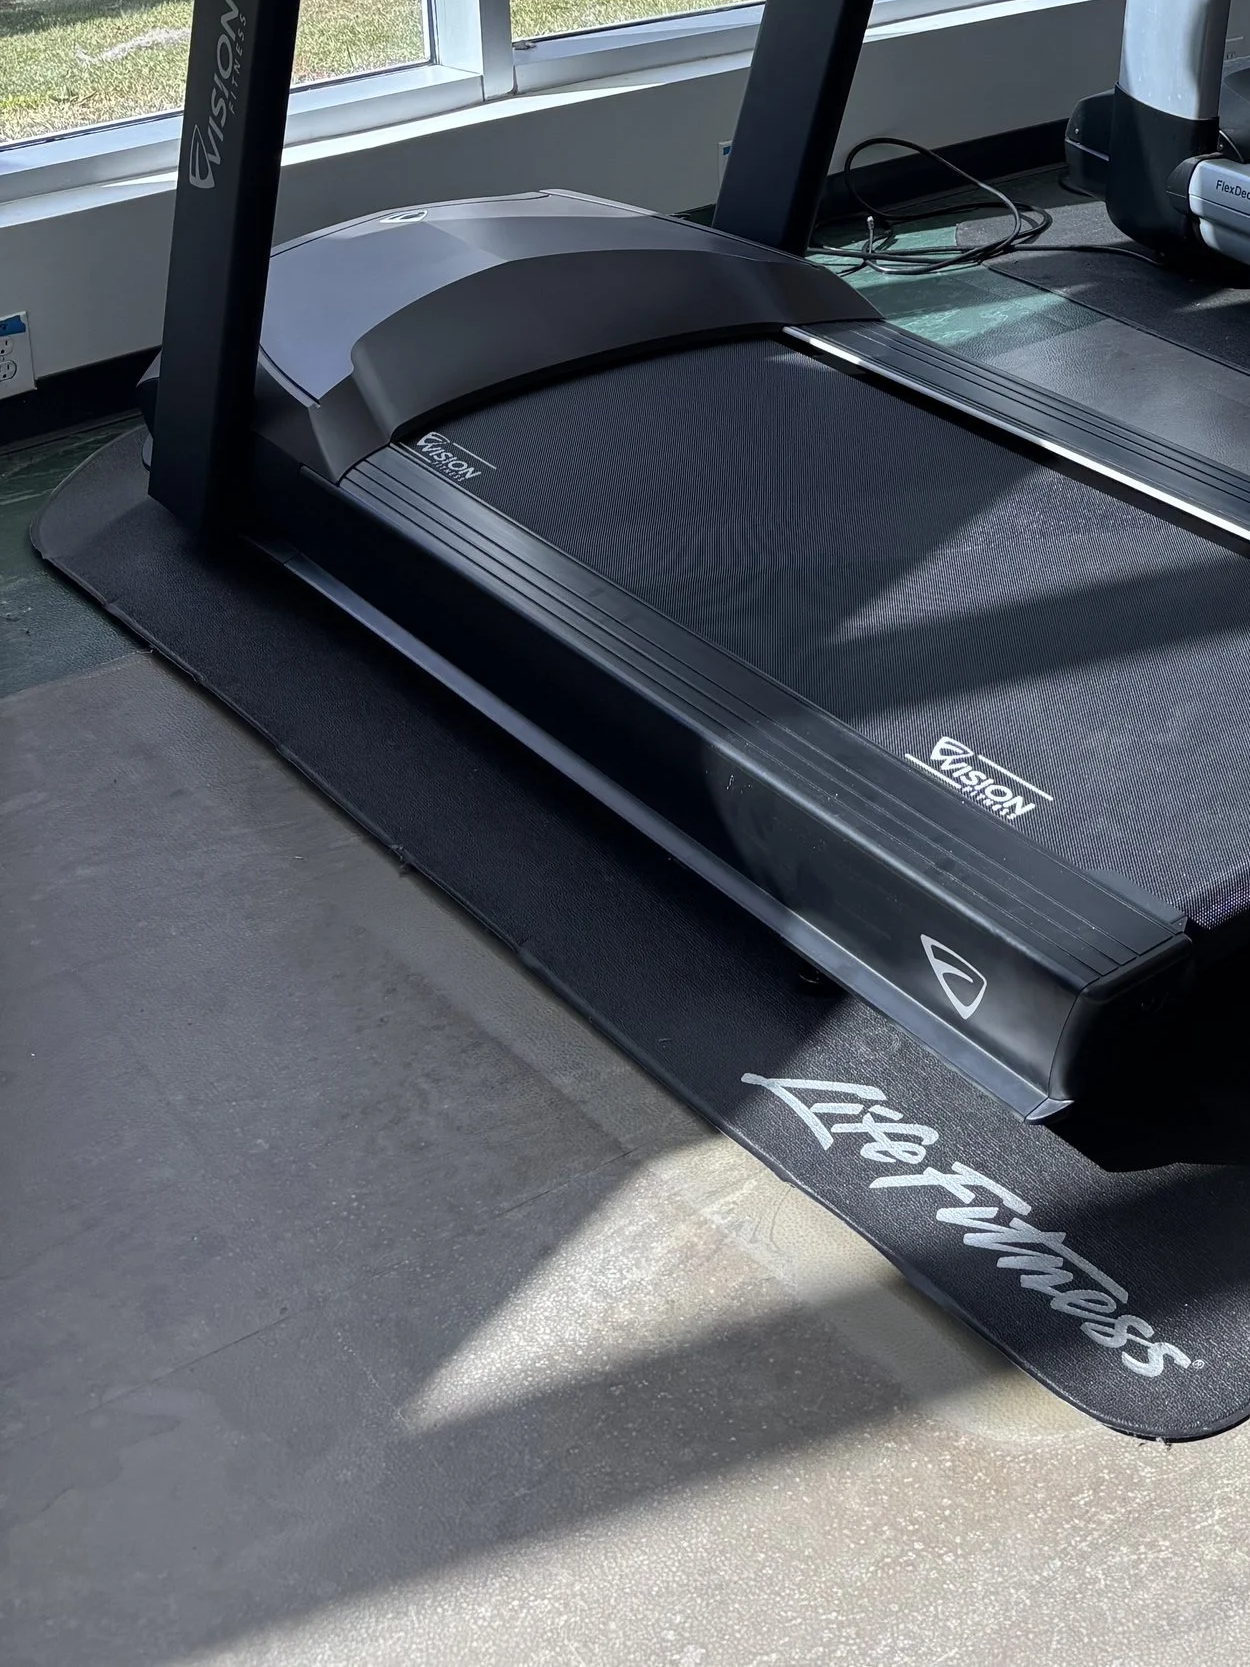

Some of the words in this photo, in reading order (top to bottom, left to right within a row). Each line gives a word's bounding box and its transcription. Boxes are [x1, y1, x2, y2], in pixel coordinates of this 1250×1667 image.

[229, 13, 247, 115] FITNESS
[422, 443, 482, 480] VISION
[940, 756, 1036, 816] VISION
